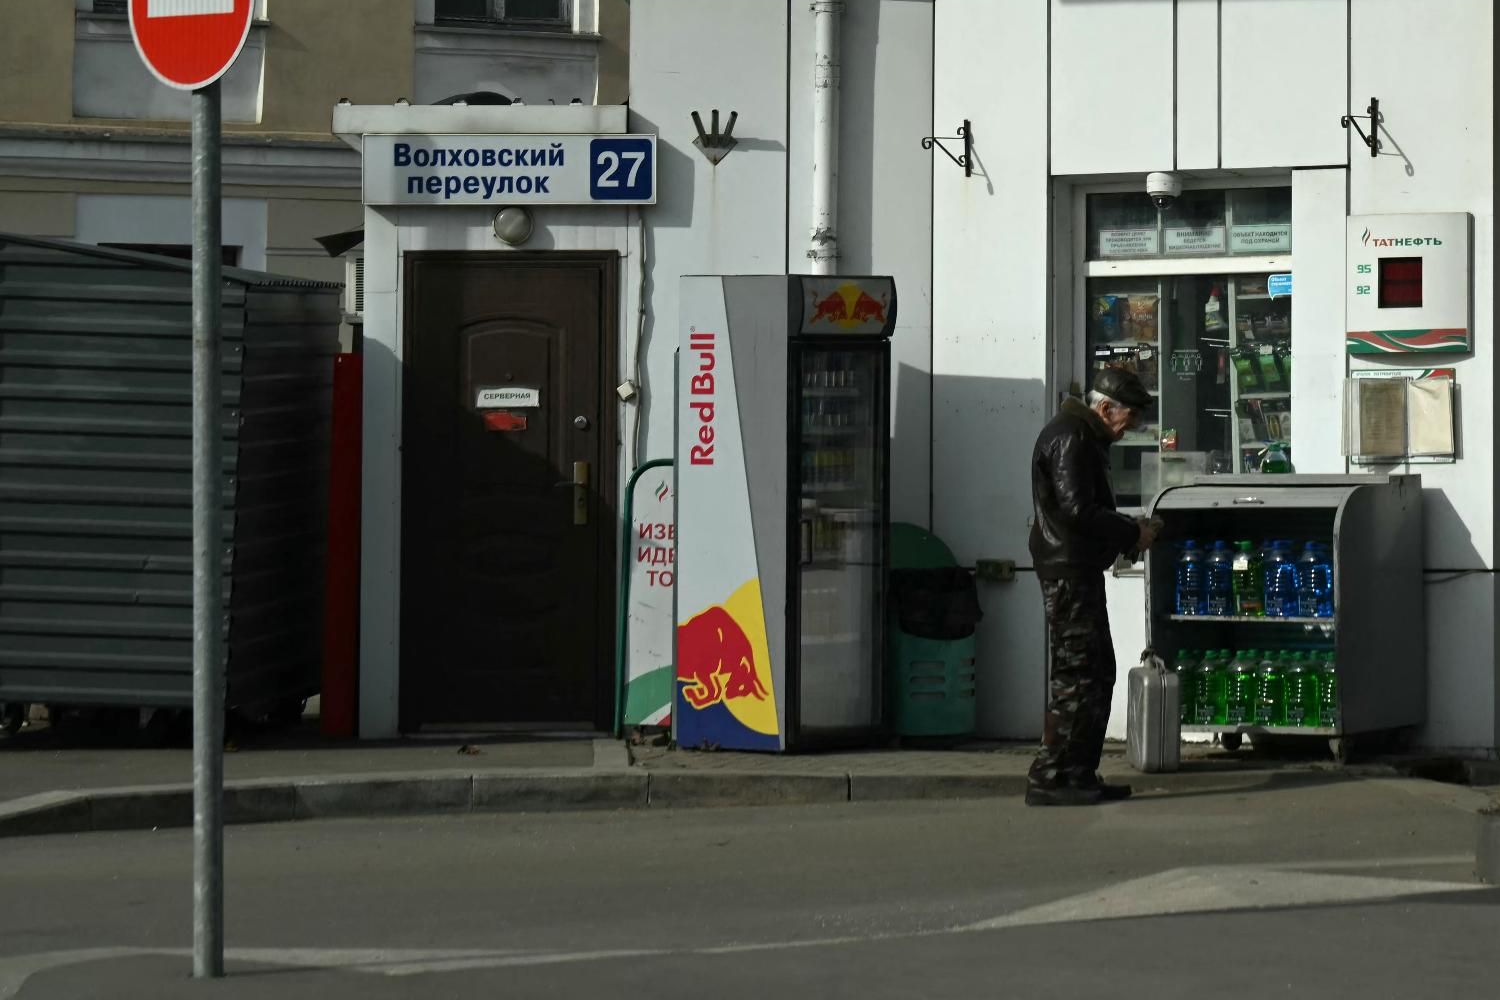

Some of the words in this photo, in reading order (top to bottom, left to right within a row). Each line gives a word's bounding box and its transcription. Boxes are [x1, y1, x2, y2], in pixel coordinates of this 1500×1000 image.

[393, 143, 565, 168] Волховский
[596, 151, 646, 188] 27
[407, 175, 550, 199] переулок
[1373, 237, 1442, 247] ТАТНЕФТЬ
[1357, 264, 1371, 273] 95
[1356, 286, 1371, 295] 92
[690, 333, 715, 395] Bull
[483, 392, 531, 400] СЕРВЕРНАЯ
[690, 402, 714, 465] Red
